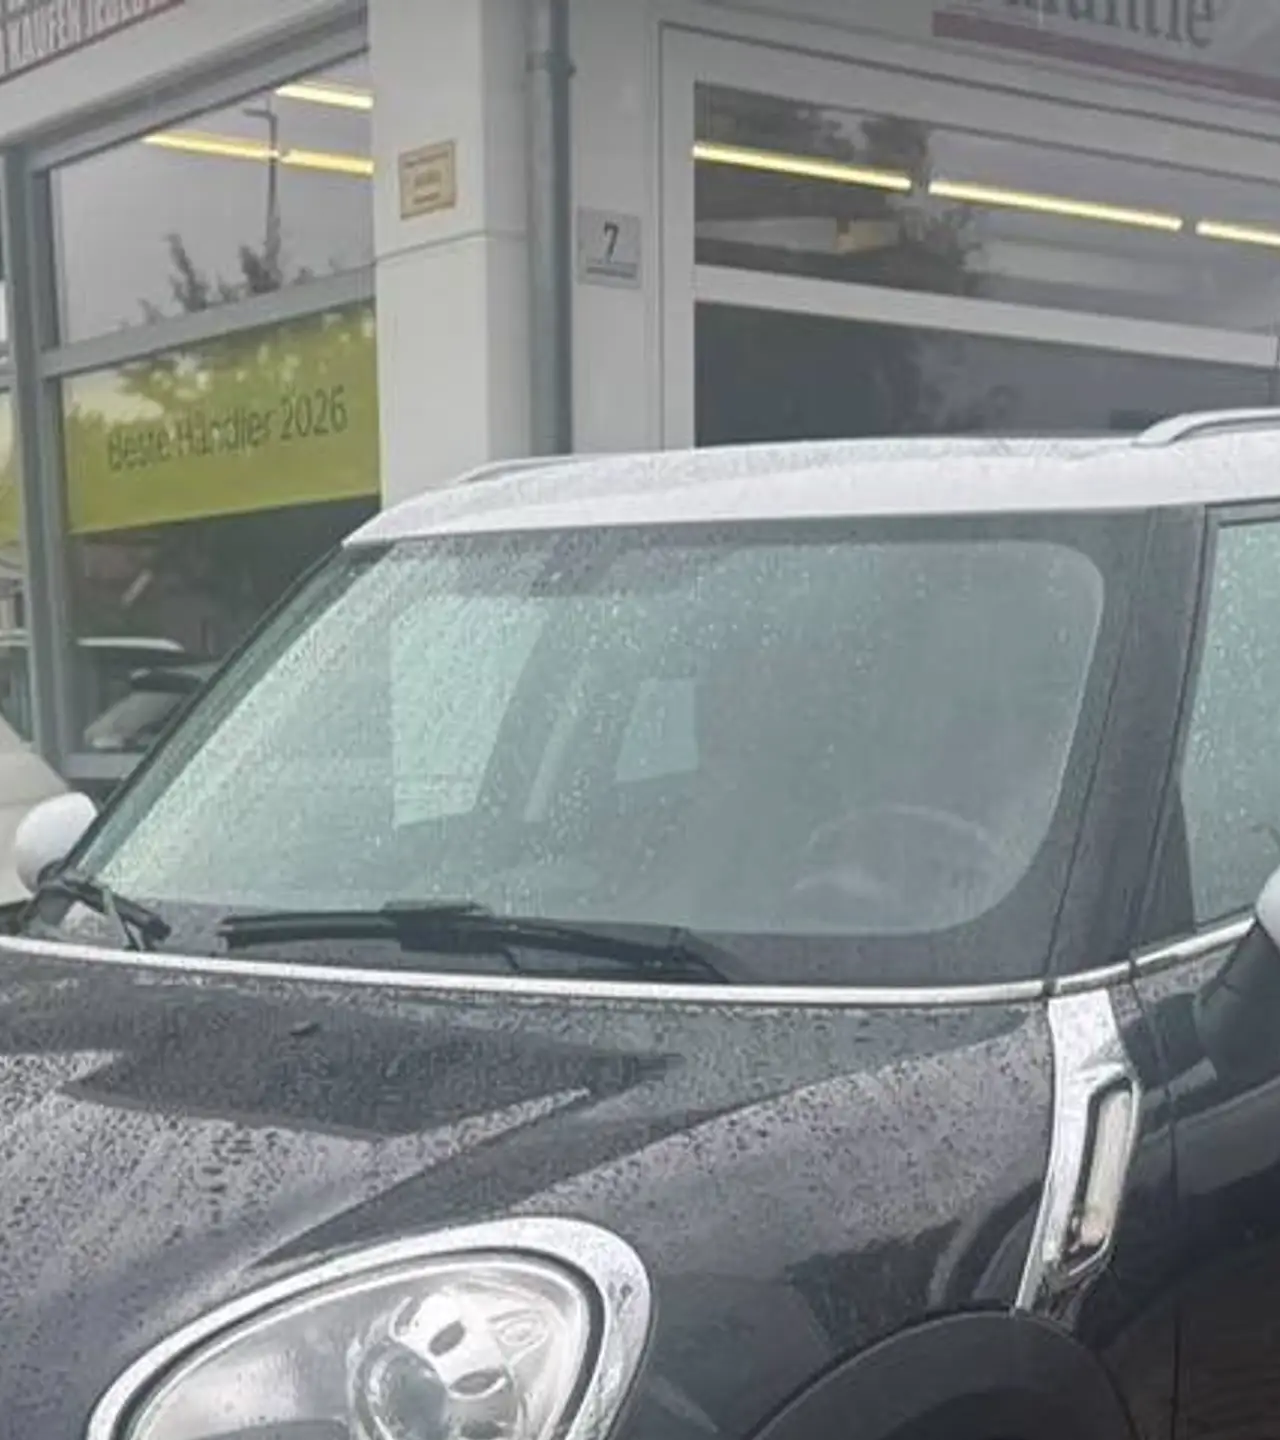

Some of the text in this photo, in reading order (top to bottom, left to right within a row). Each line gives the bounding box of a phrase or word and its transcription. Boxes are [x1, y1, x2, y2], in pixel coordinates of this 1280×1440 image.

[603, 220, 620, 264] 7
[107, 425, 170, 471] Beste
[280, 383, 348, 441] 2026
